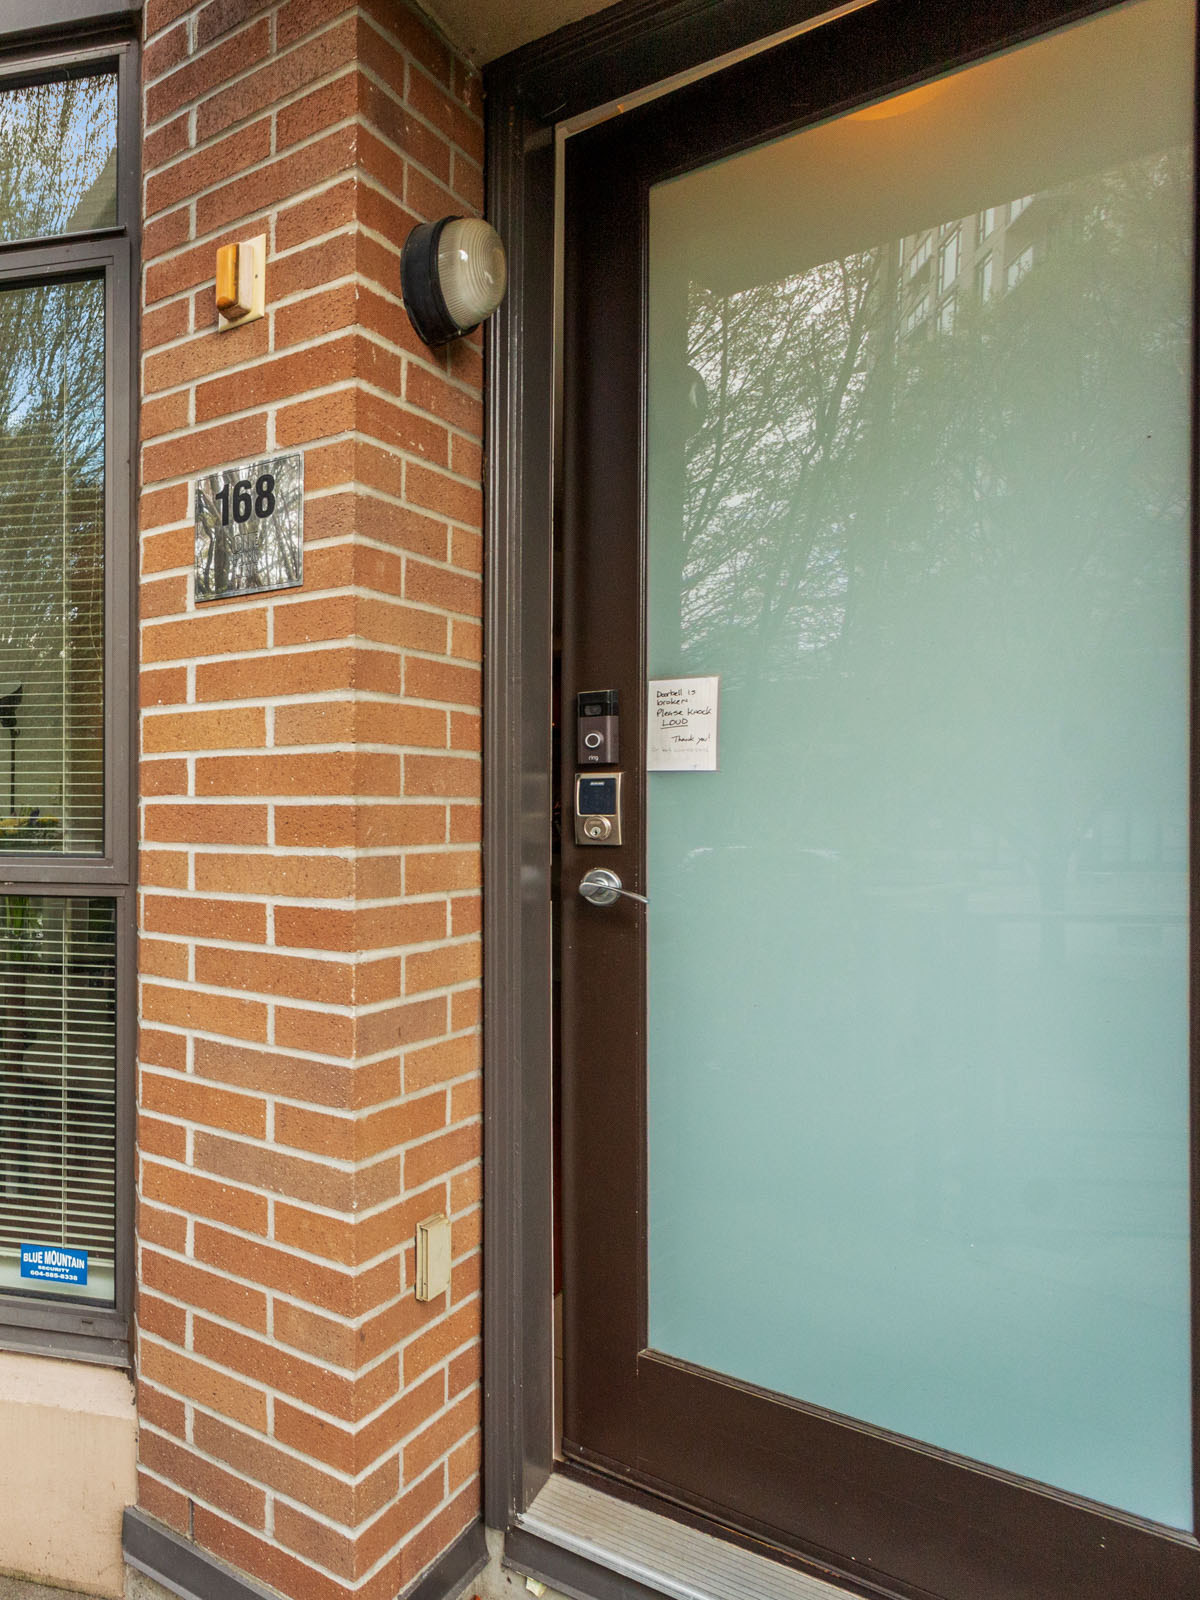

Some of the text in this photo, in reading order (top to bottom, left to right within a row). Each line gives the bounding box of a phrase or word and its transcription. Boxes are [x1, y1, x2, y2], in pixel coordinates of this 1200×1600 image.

[215, 474, 276, 526] 168
[656, 688, 683, 698] Doorbell
[656, 707, 684, 717] Please
[662, 718, 688, 727] LOUD
[672, 734, 695, 743] Thank
[23, 1250, 85, 1269] BLUE MOUNTAIN
[38, 1265, 70, 1273] SECURITY
